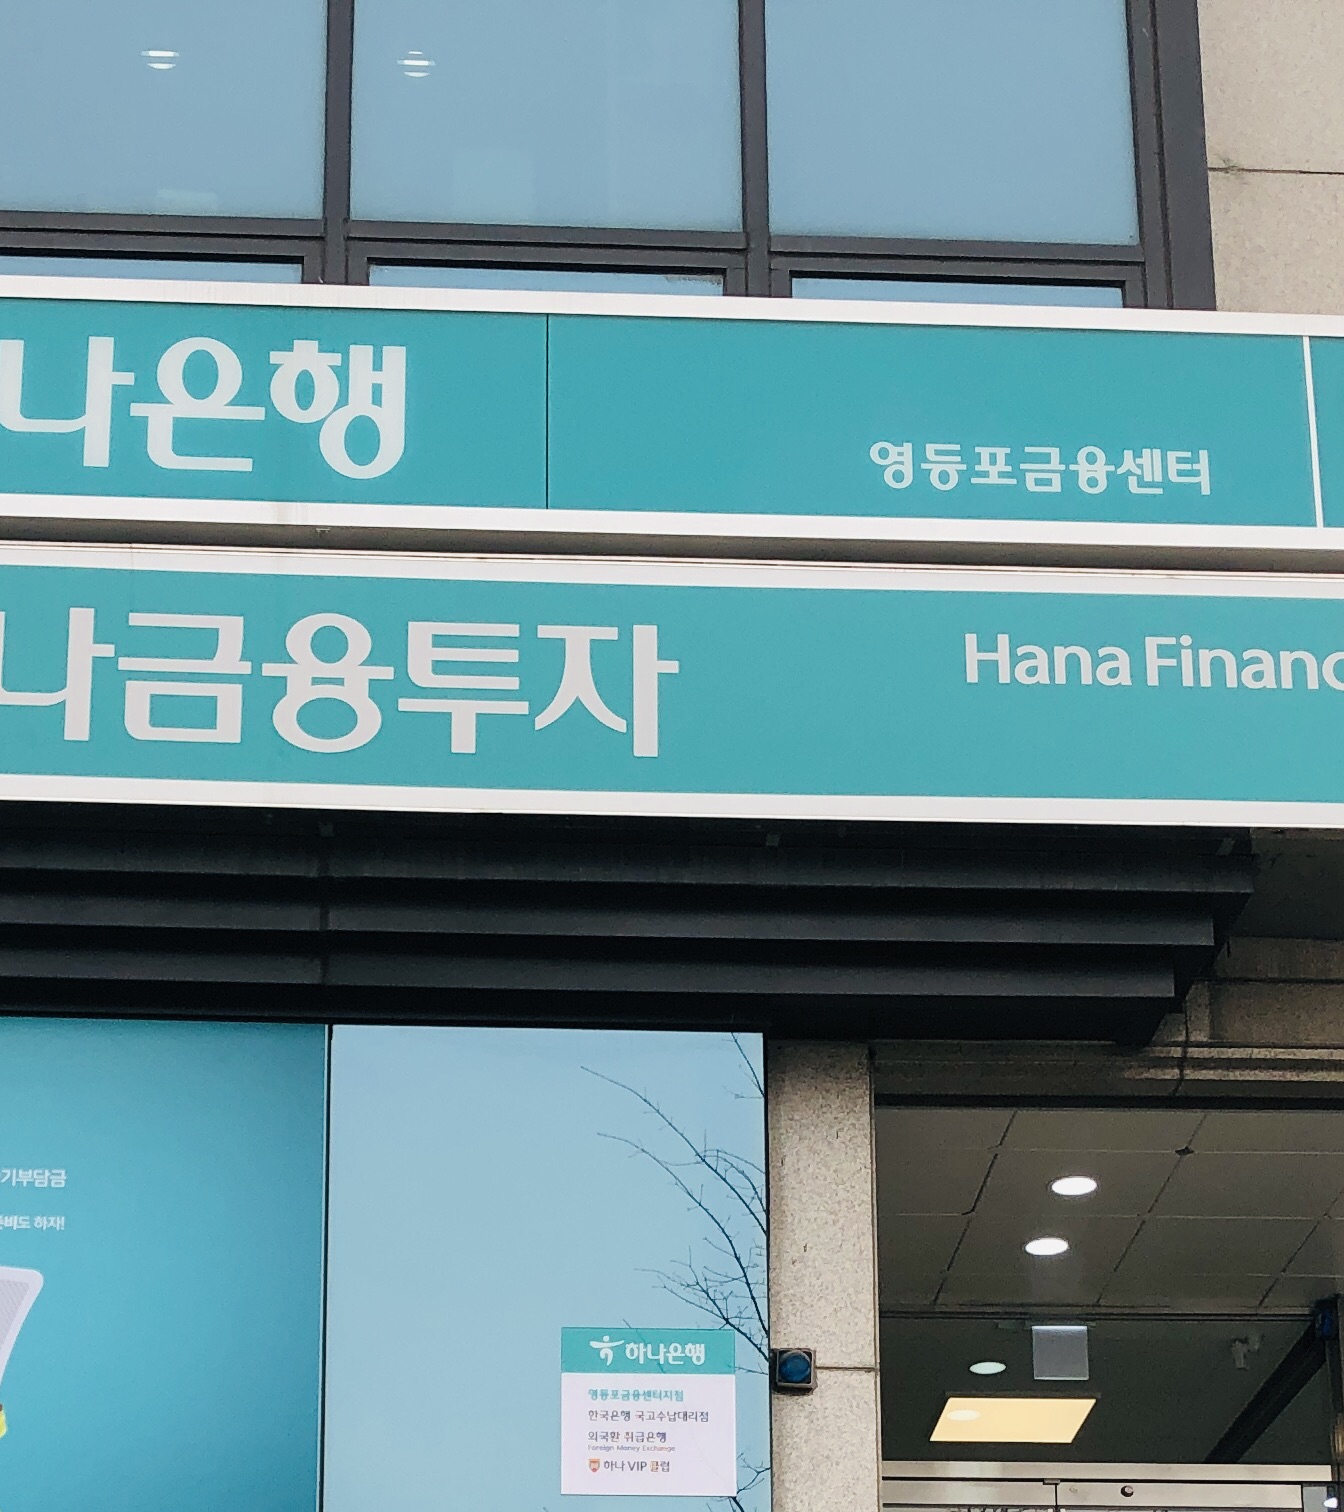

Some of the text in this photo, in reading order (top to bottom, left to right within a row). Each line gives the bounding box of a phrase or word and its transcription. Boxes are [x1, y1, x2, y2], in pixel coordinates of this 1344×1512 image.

[869, 440, 1212, 495] 영등포금융센터
[963, 633, 1131, 686] Hana
[625, 1342, 705, 1366] 하나은행
[588, 1388, 684, 1402] 영등포금융센터지점
[588, 1410, 709, 1422] 한국은행 국고수납대리점
[588, 1431, 620, 1443] 외국환
[603, 1460, 625, 1472] 하나
[627, 1461, 648, 1471] VIP
